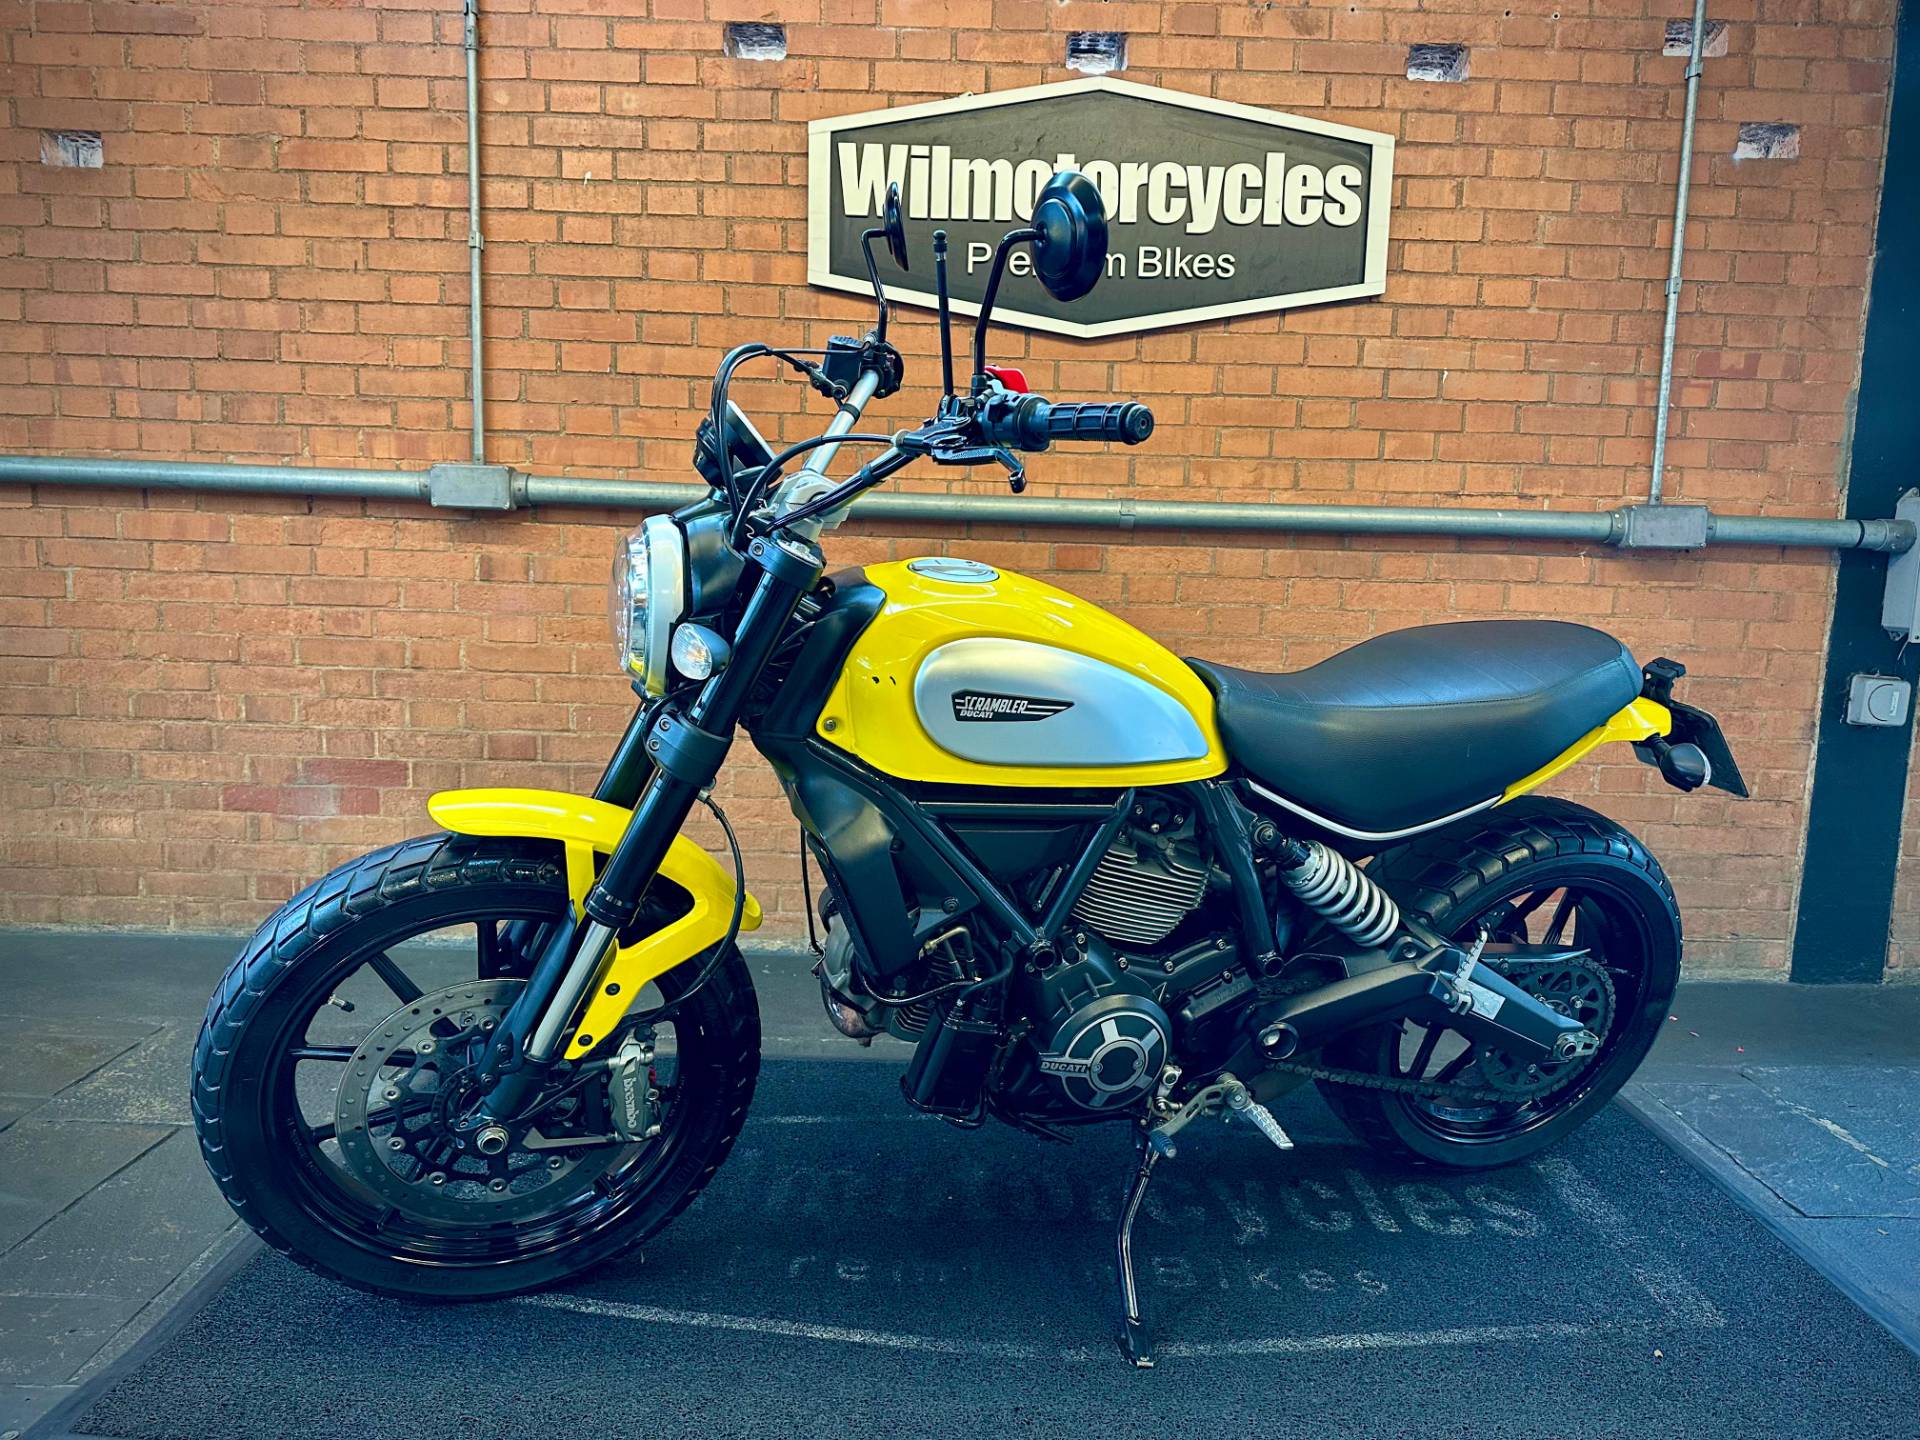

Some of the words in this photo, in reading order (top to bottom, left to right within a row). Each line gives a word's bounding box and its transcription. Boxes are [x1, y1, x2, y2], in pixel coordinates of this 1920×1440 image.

[837, 142, 1363, 234] Wilmoorcycles
[960, 709, 994, 719] DUCATI
[963, 696, 1028, 714] SCRAMBLER
[1041, 1061, 1087, 1073] DUCATI
[623, 1077, 640, 1129] brembo
